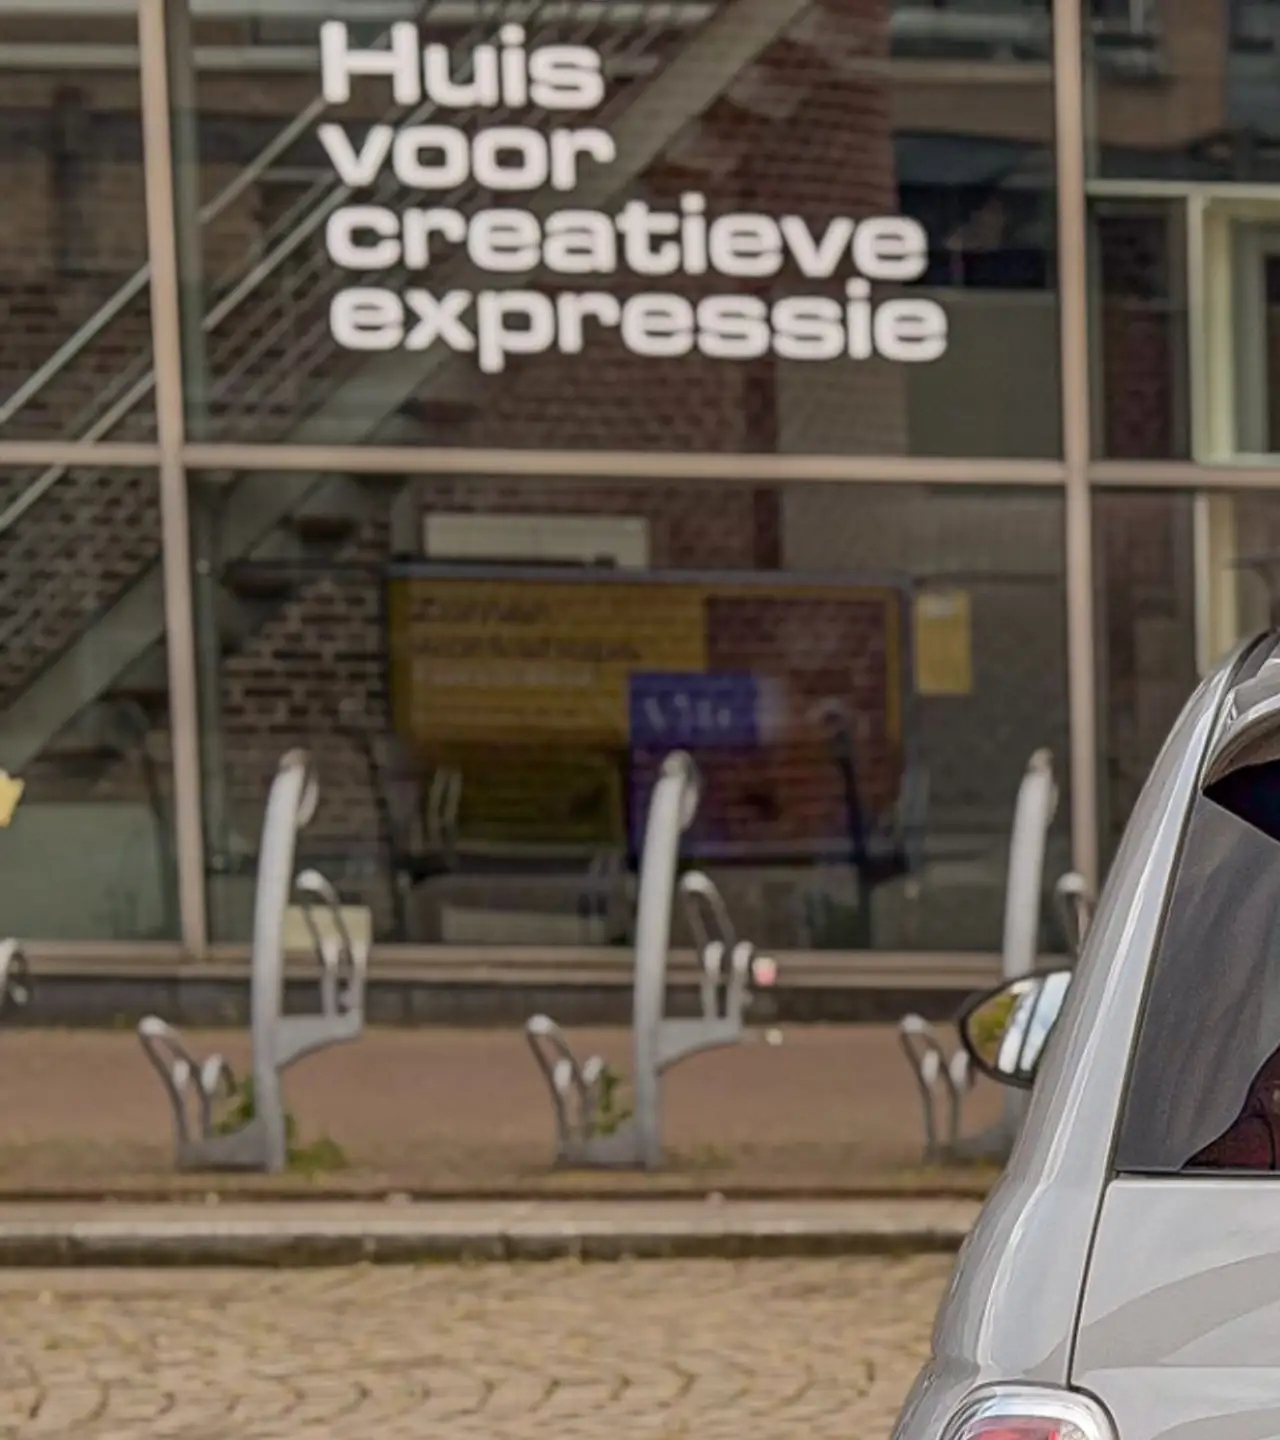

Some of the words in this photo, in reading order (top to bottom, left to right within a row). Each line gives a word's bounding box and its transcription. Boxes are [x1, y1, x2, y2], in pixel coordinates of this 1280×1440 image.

[320, 21, 605, 110] Huis
[317, 123, 616, 191] voor
[325, 193, 929, 280] creatieve
[330, 277, 948, 373] expressie
